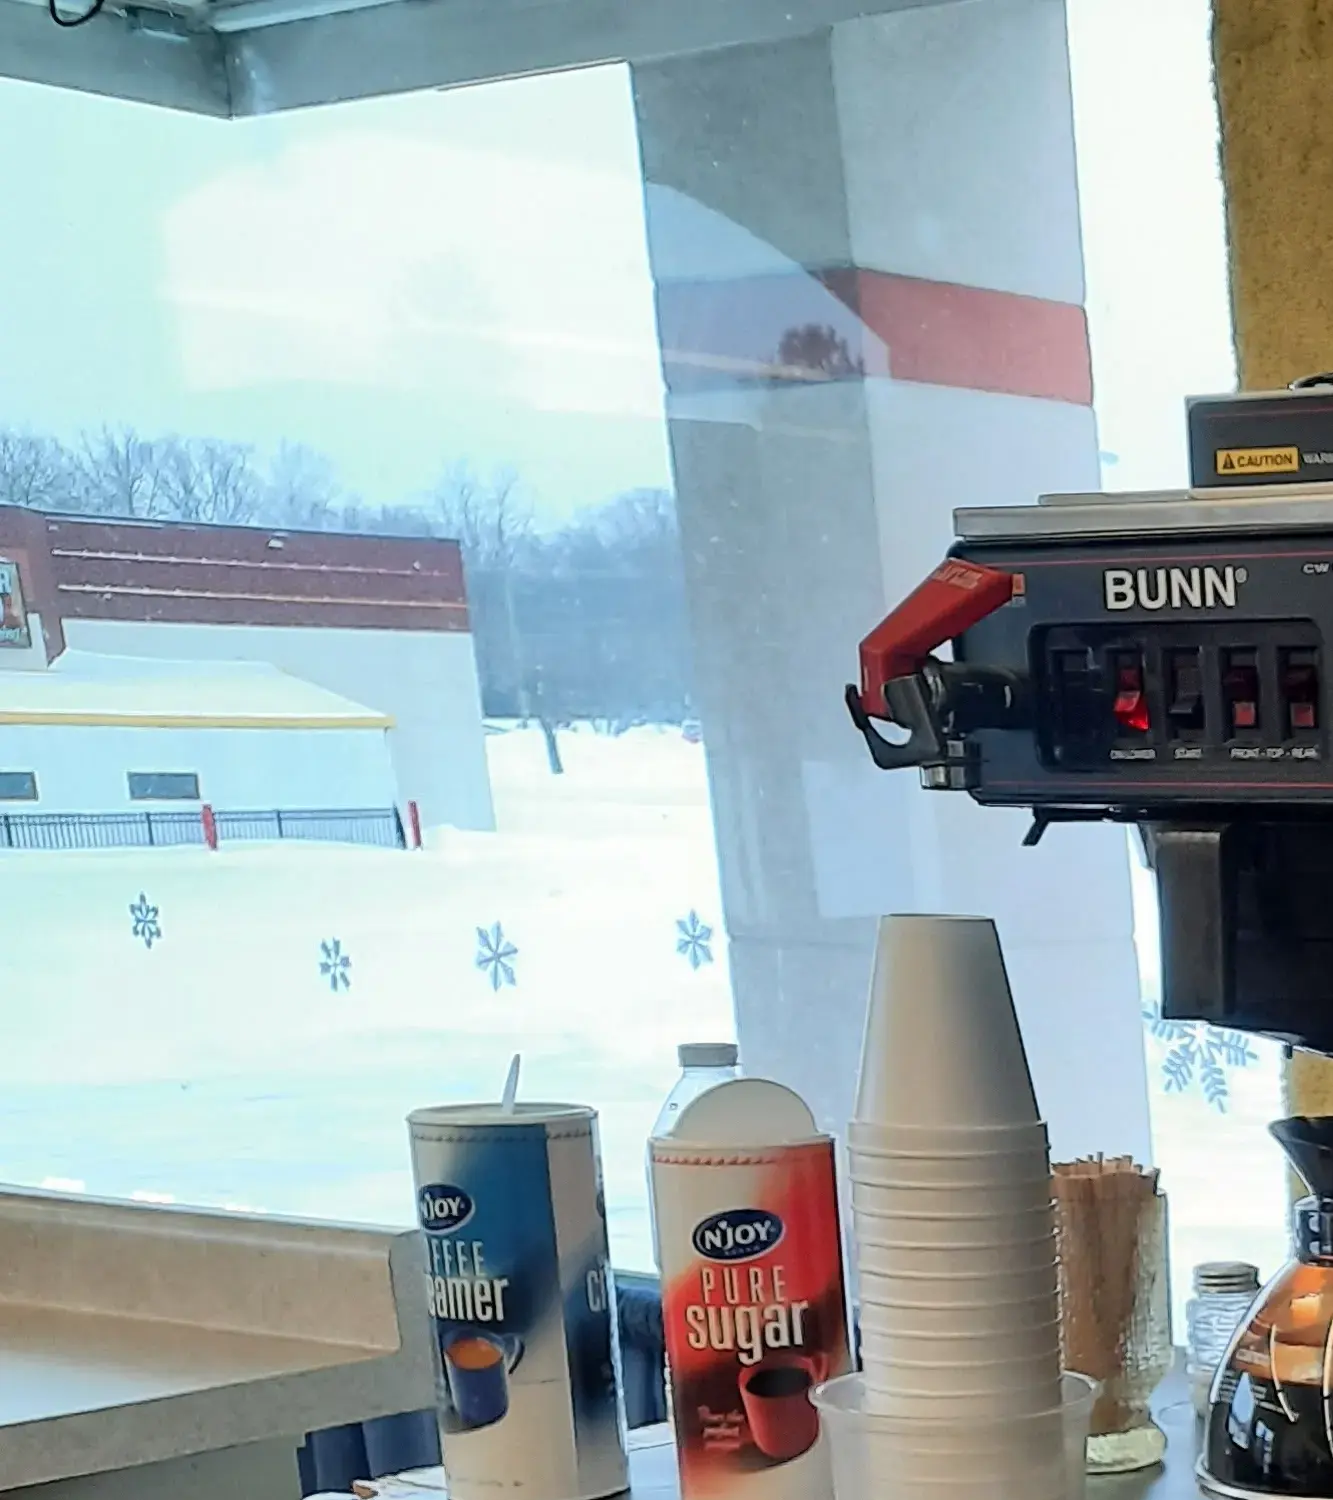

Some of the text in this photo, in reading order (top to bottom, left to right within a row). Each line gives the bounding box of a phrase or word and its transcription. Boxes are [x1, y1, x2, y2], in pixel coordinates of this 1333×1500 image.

[1237, 453, 1293, 468] CAUTION
[1302, 562, 1330, 574] CW
[1104, 566, 1237, 611] BUNN
[425, 1239, 486, 1277] FFEE
[701, 1264, 787, 1305] PURE
[685, 1300, 809, 1366] sugar
